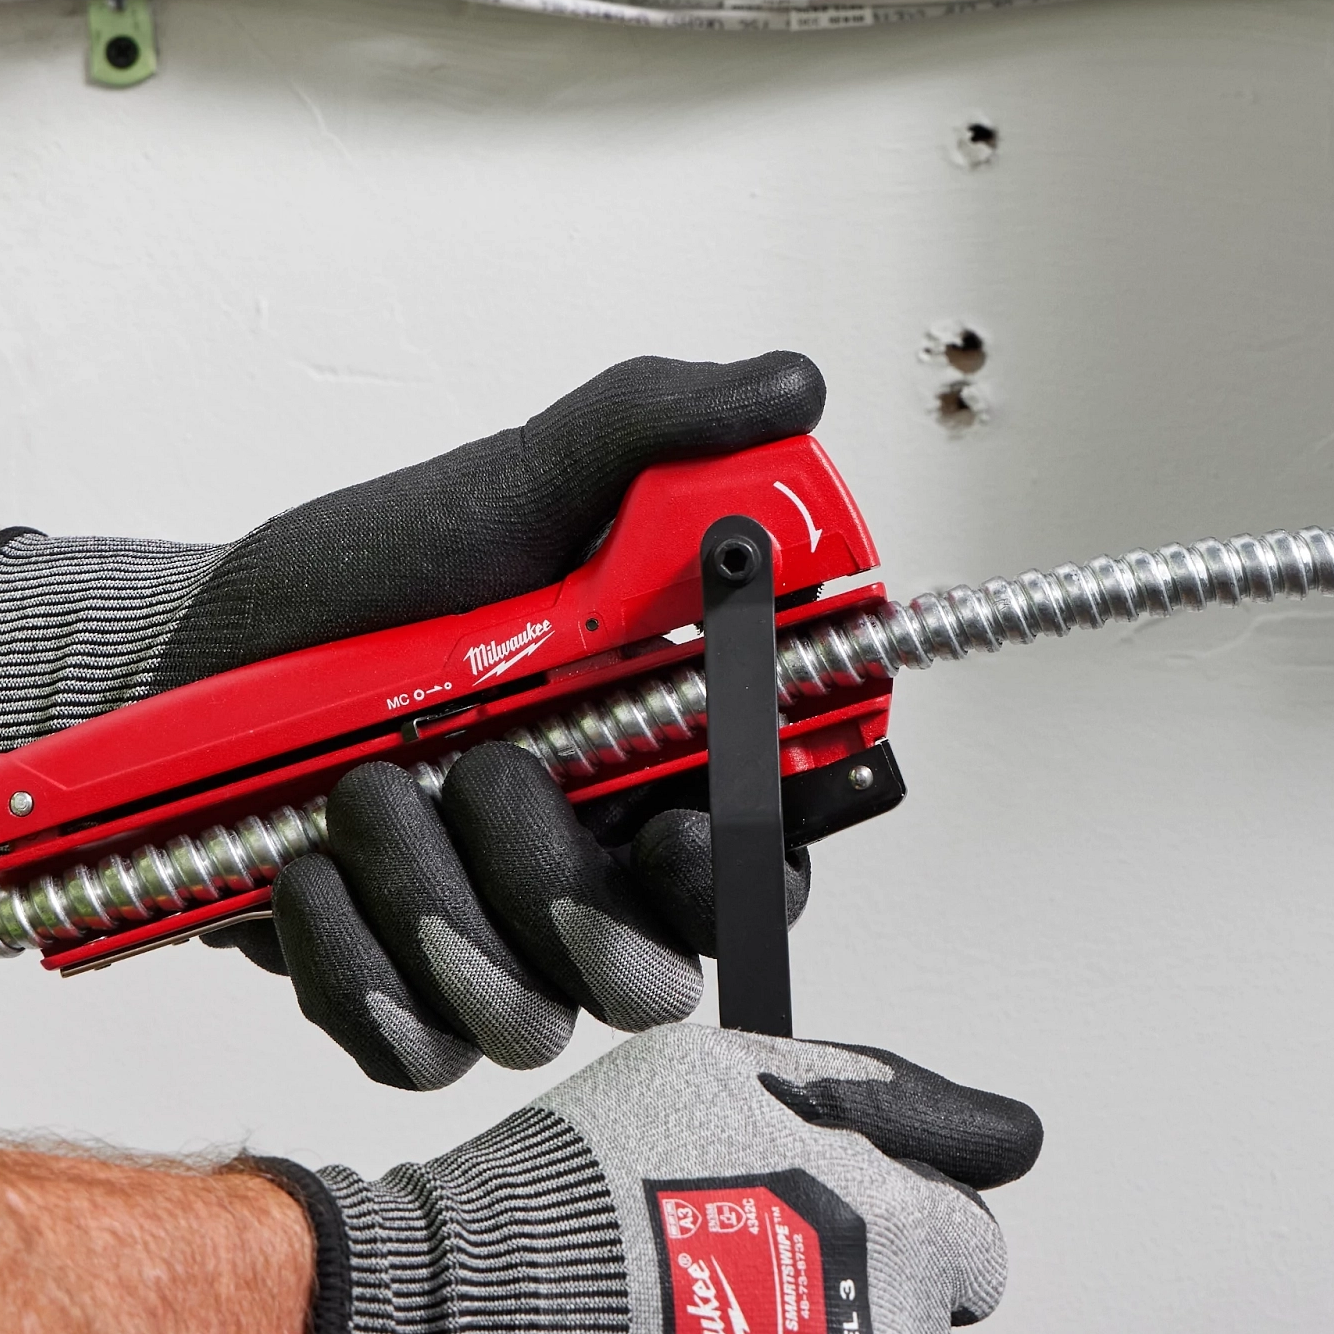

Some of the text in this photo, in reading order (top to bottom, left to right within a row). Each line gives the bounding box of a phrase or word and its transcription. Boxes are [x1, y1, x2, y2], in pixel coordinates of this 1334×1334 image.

[463, 619, 552, 676] Milwaukee
[386, 693, 410, 711] MC
[677, 1207, 695, 1230] A3
[742, 1198, 760, 1235] 4342C
[792, 1232, 810, 1320] 48-73-8732
[839, 1279, 856, 1301] 3
